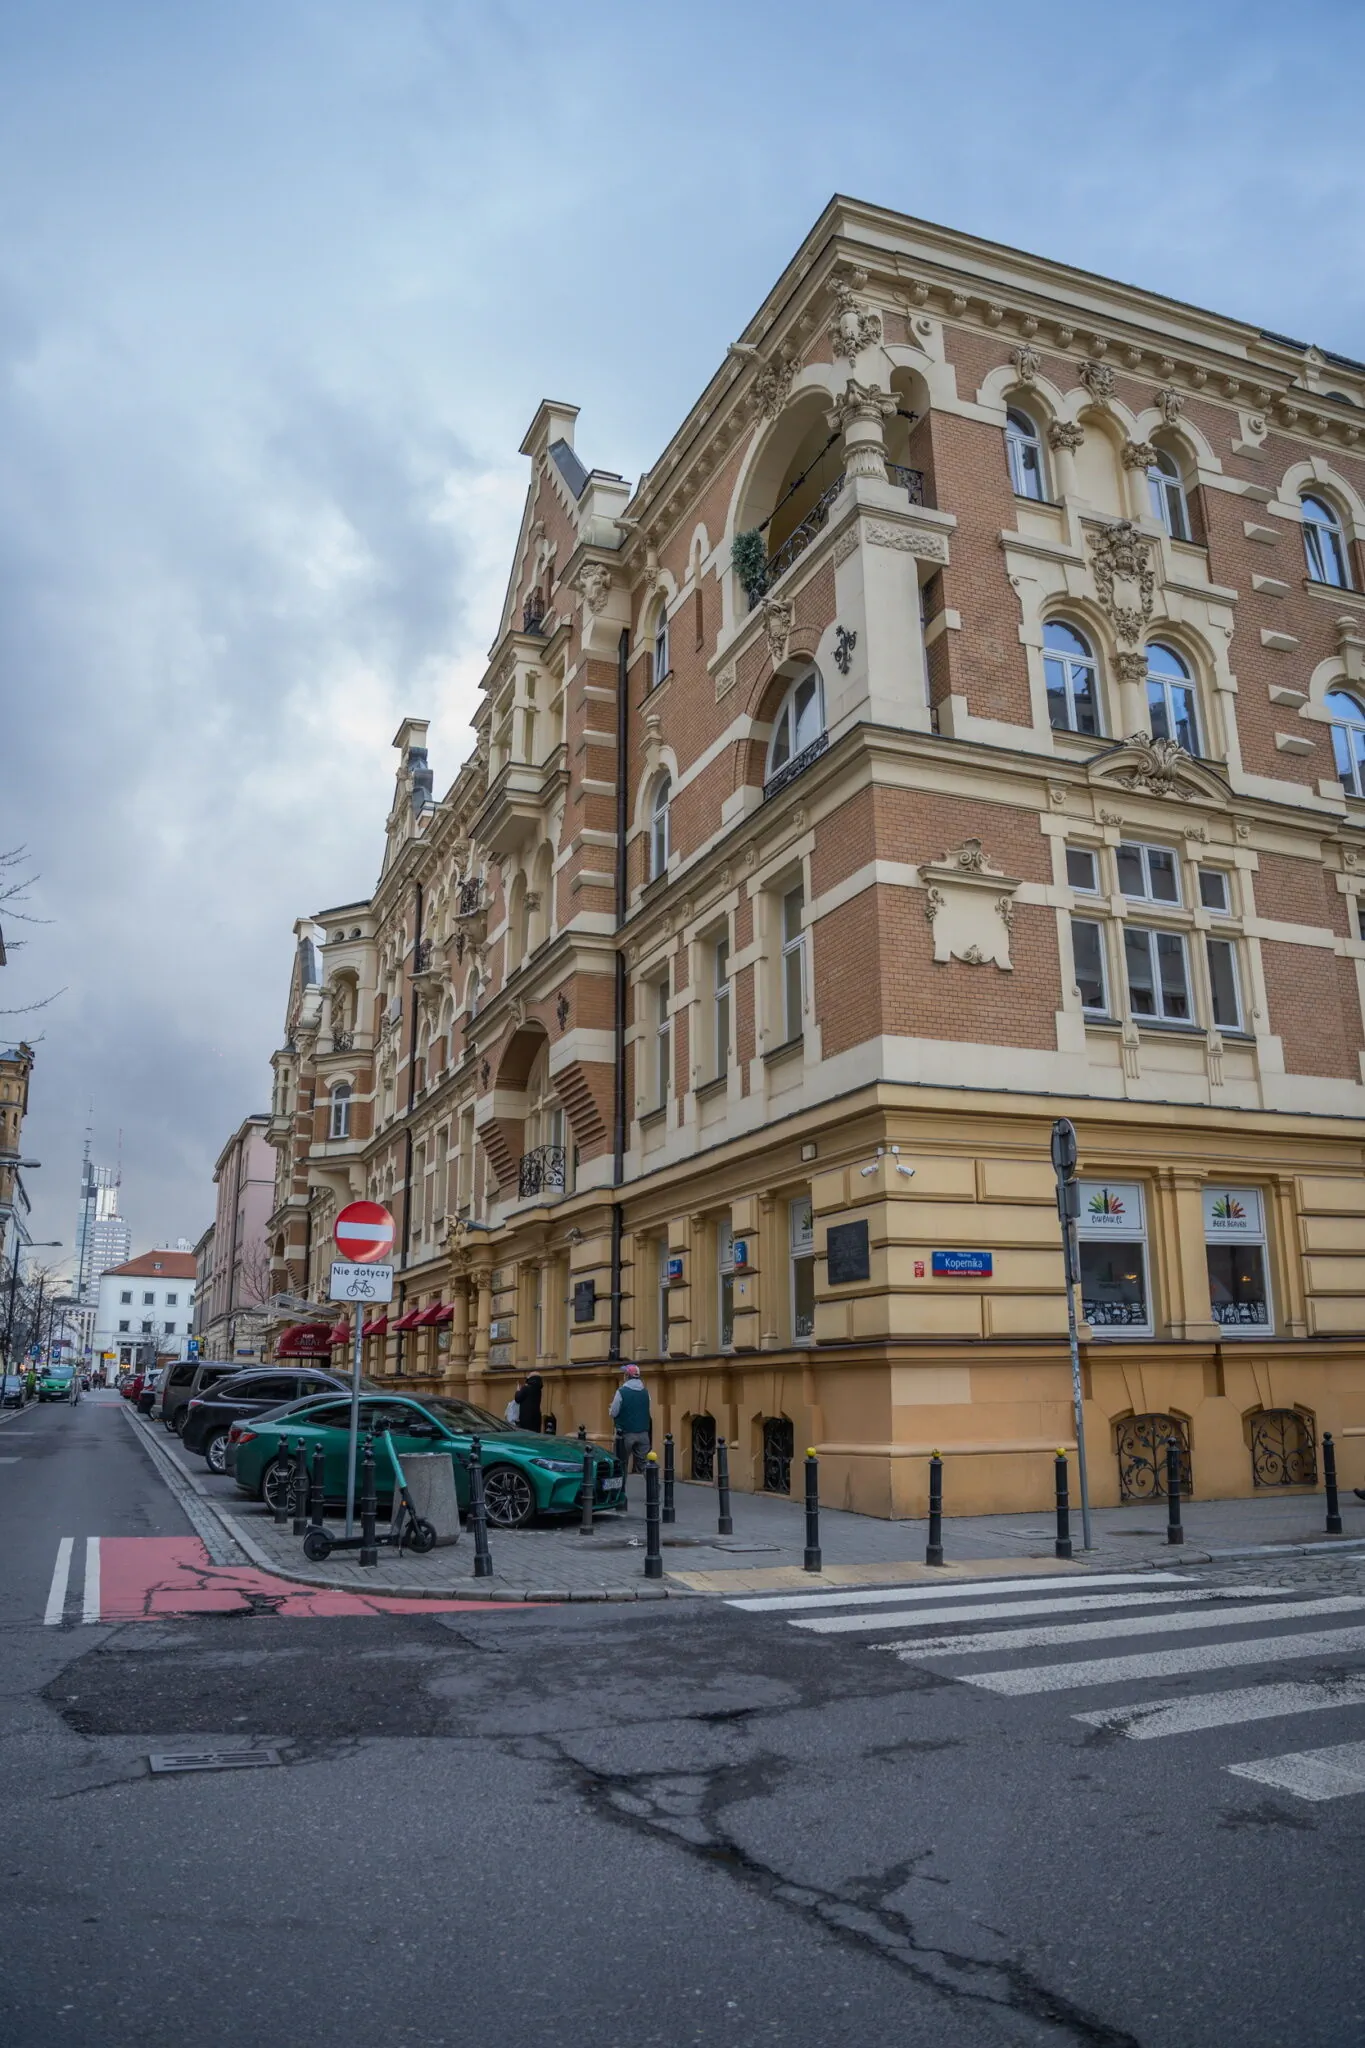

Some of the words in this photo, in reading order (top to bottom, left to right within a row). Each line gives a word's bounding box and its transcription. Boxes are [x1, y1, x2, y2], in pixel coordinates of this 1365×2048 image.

[945, 1258, 983, 1269] Kopernika
[333, 1266, 350, 1275] Nie
[354, 1268, 390, 1279] dotyczy
[32, 1345, 38, 1353] P
[190, 1341, 196, 1350] P
